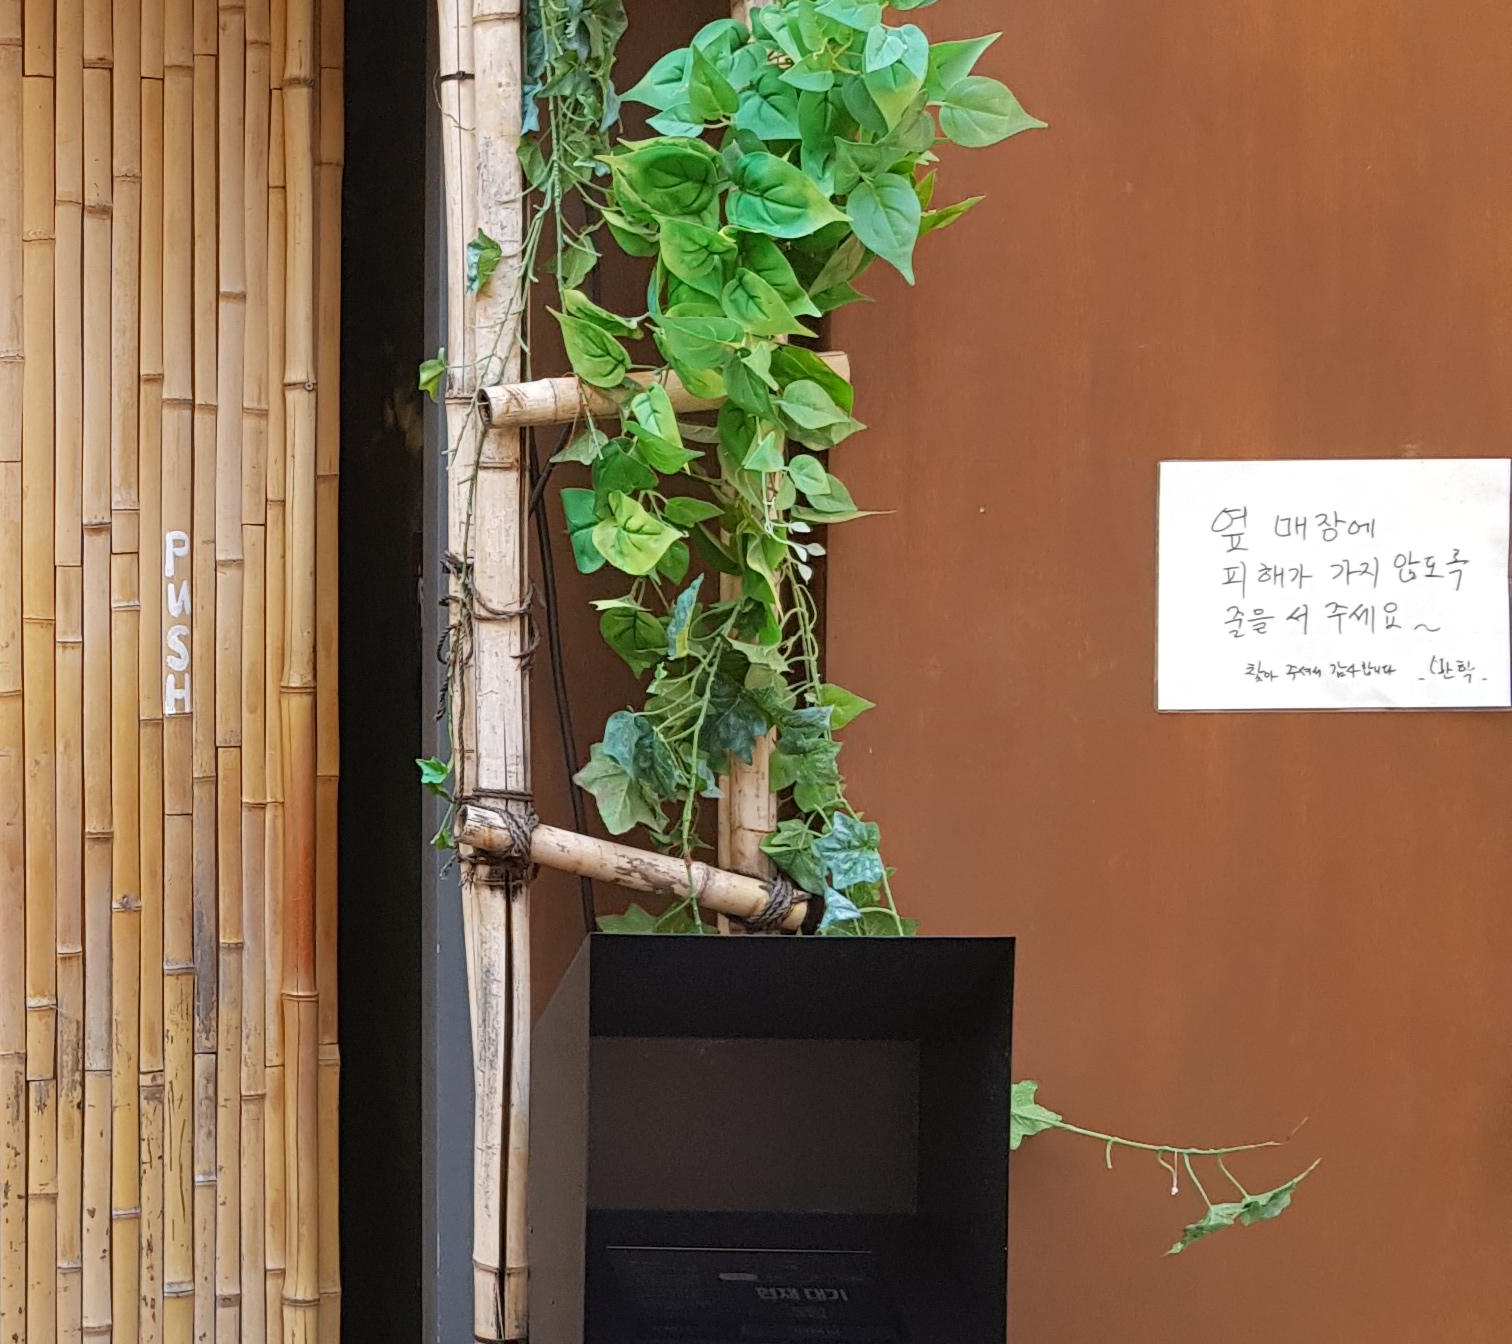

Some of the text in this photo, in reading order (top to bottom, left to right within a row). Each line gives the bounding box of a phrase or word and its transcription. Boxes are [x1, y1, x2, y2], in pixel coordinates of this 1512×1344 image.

[1211, 506, 1375, 553] 옆 매장에
[1222, 548, 1470, 599] 피해가 가지 않도록
[164, 530, 192, 716] PUSH
[1224, 606, 1275, 638] 줄을
[1330, 661, 1397, 678] 감사합니다
